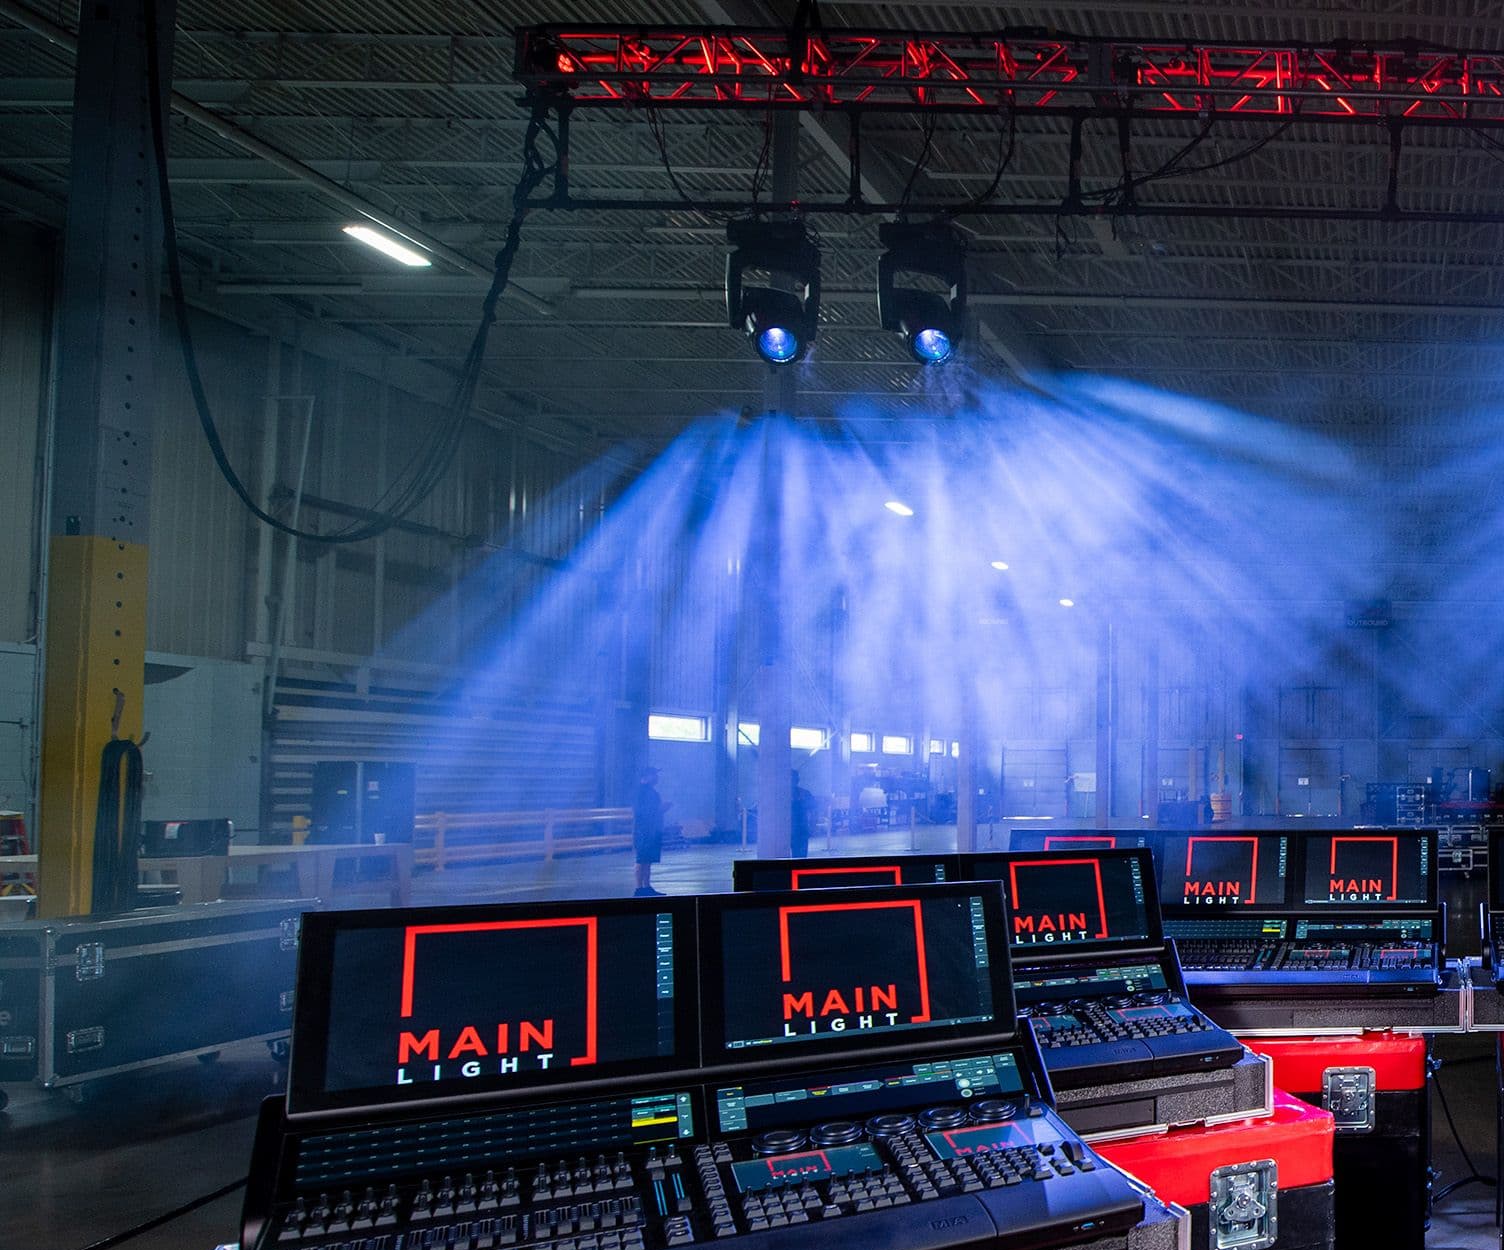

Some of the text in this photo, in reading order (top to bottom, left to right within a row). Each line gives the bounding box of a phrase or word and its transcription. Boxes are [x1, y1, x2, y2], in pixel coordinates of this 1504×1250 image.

[1184, 881, 1240, 896] MAIN
[1329, 879, 1382, 893] MAIN
[1183, 896, 1240, 905] LIGHT
[1329, 893, 1382, 902] LIGHT
[1013, 912, 1087, 934] MAIN
[1014, 930, 1087, 945] LIGHT
[782, 983, 898, 1020] MAIN
[784, 1012, 898, 1037] LIGHT
[397, 1019, 554, 1064] MAIN
[397, 1053, 554, 1085] LIGHT
